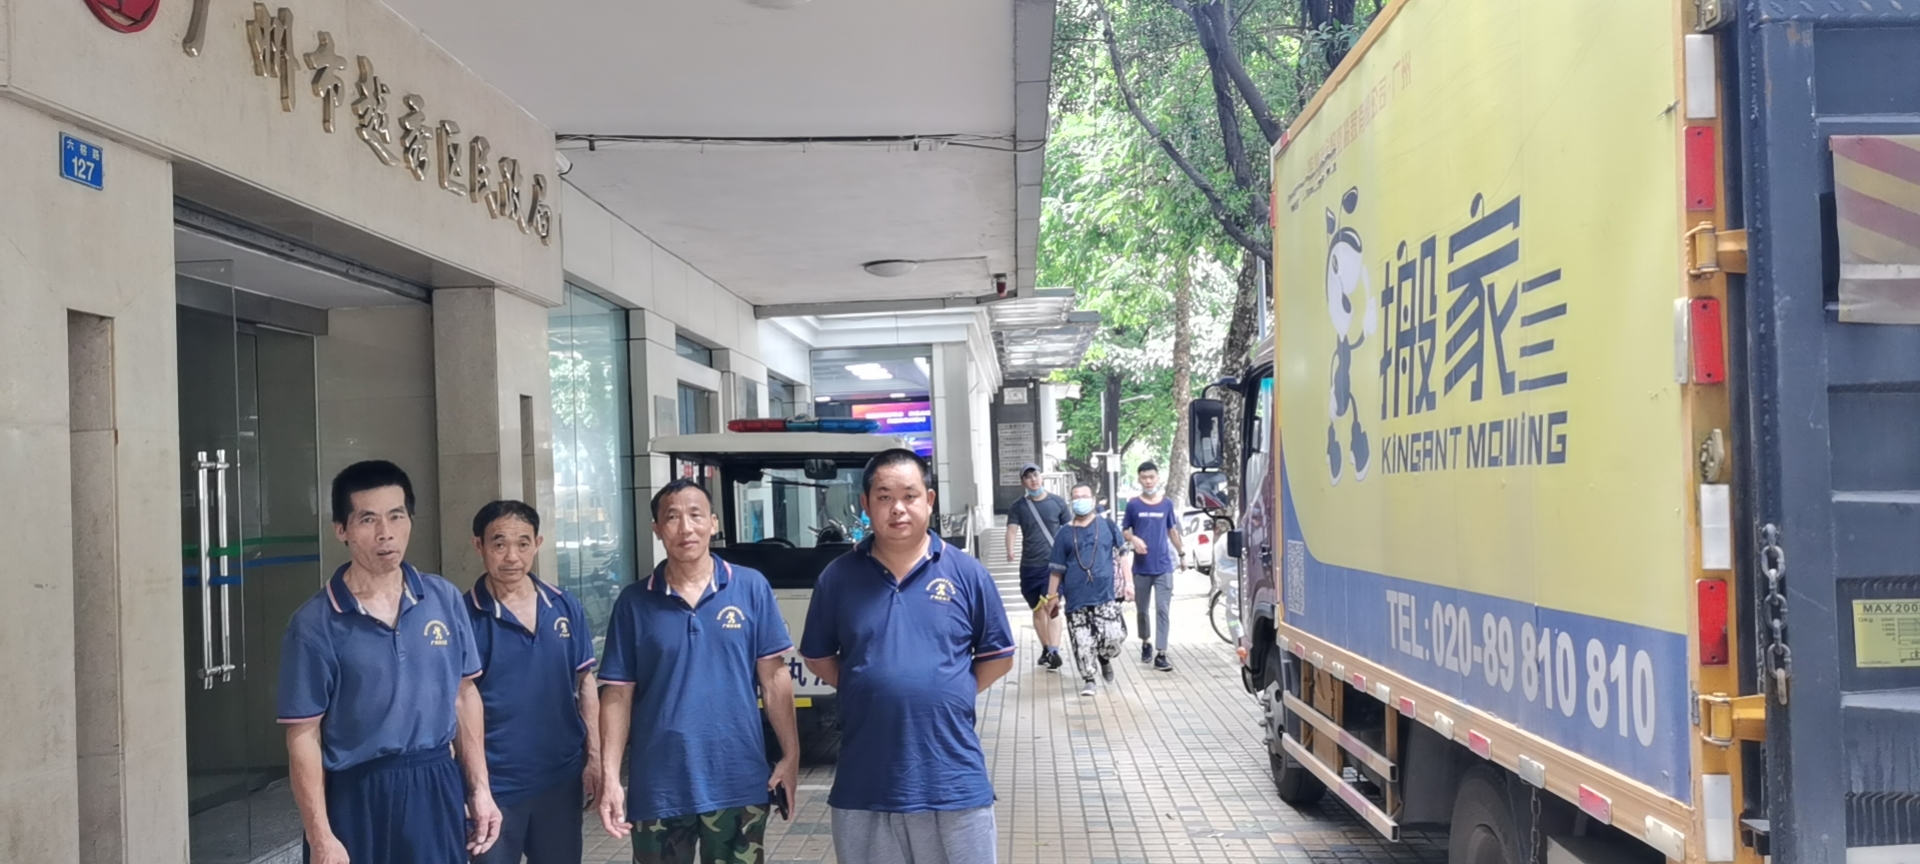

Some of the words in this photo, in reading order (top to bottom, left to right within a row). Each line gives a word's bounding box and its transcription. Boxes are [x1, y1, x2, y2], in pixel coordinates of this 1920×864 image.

[72, 156, 95, 181] 127
[1380, 192, 1521, 421] 搬家
[1862, 604, 1892, 613] MAX
[1895, 603, 1920, 613] 200
